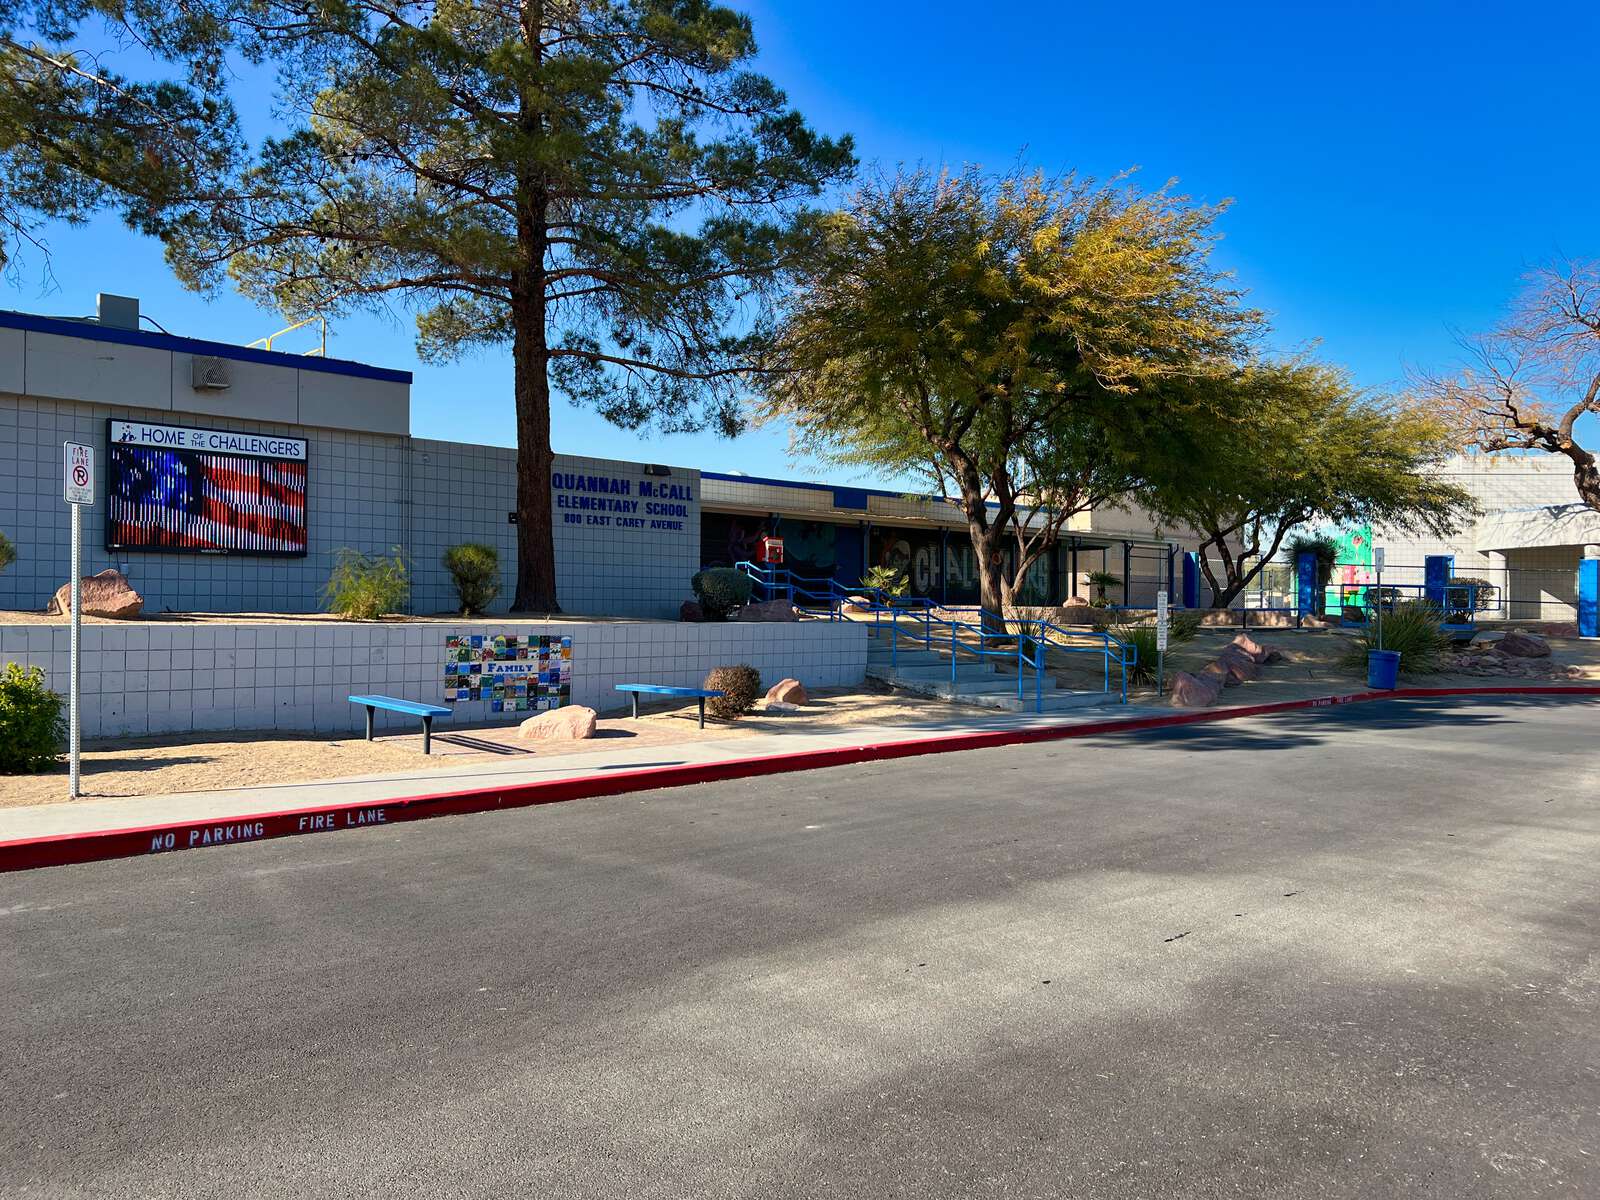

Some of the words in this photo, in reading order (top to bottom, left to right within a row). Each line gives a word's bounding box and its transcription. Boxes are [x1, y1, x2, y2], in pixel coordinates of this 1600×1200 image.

[141, 427, 185, 446] HOME
[190, 439, 206, 448] THE
[192, 432, 204, 440] OF
[72, 447, 89, 458] FIRE
[209, 434, 300, 457] CHALLENGERS
[71, 457, 89, 467] LANE
[552, 472, 630, 496] QUANNAH
[557, 494, 639, 514] ELEMENTARY
[645, 502, 689, 518] SCHOOL
[586, 515, 610, 526] EAST
[616, 517, 646, 529] CAREY
[650, 520, 684, 531] AVENUE
[487, 663, 534, 673] FAMILY
[151, 833, 176, 850] NO
[189, 822, 264, 847] PARKING
[299, 813, 335, 831] FIRE
[347, 808, 386, 826] LANE
